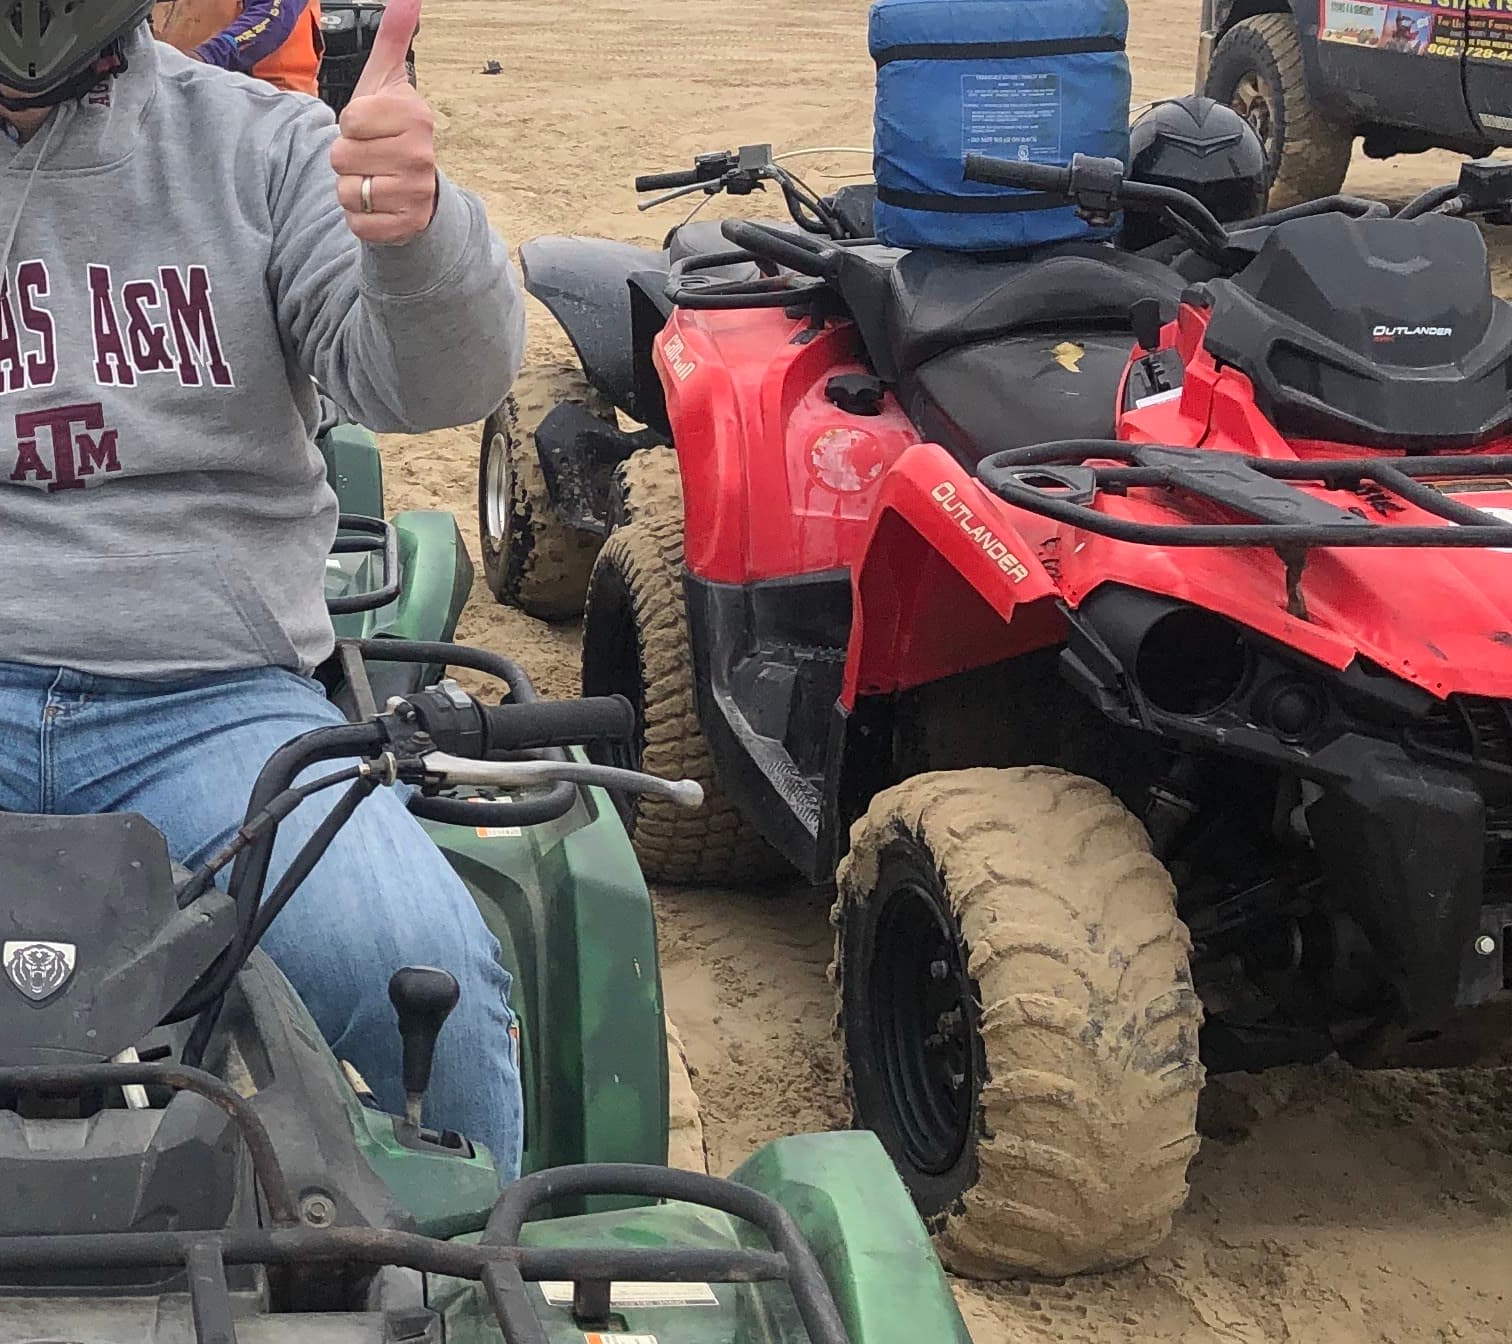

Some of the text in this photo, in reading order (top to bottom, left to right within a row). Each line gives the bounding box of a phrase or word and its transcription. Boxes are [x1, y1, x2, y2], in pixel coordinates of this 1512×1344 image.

[87, 262, 236, 388] A&M
[1372, 325, 1452, 337] OUTLANDER
[931, 480, 1029, 584] OUTLANDER
